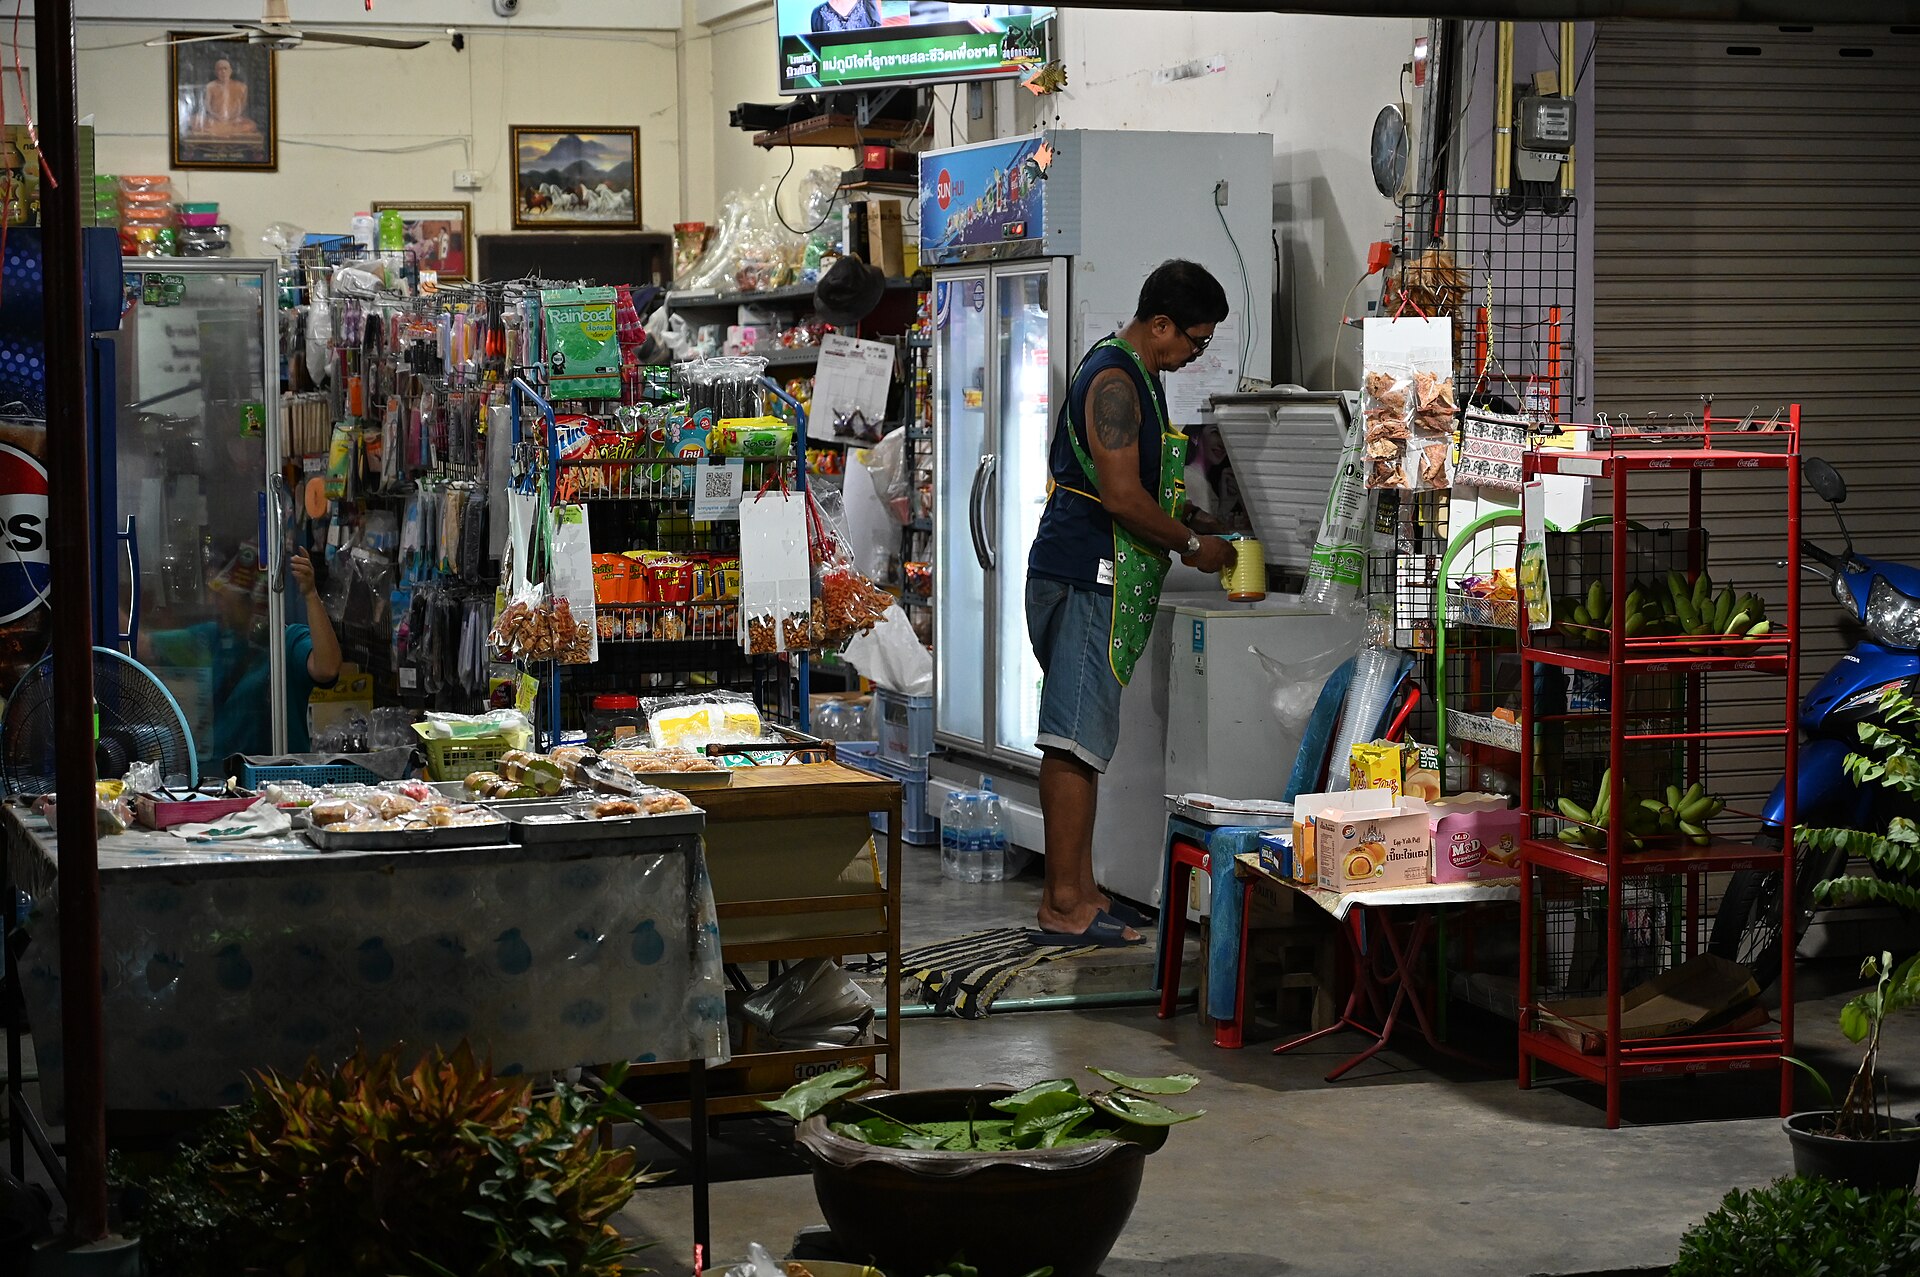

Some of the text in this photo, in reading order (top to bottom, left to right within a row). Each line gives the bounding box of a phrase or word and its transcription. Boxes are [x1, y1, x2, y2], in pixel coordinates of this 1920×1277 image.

[823, 42, 997, 74] แม่ภูมิใจที่ลูกชายสละชีวิตเพื่อชาติ
[938, 181, 950, 199] SUN
[548, 308, 612, 323] Raincoat
[1452, 839, 1481, 856] M&D
[1453, 852, 1481, 863] Strawberry
